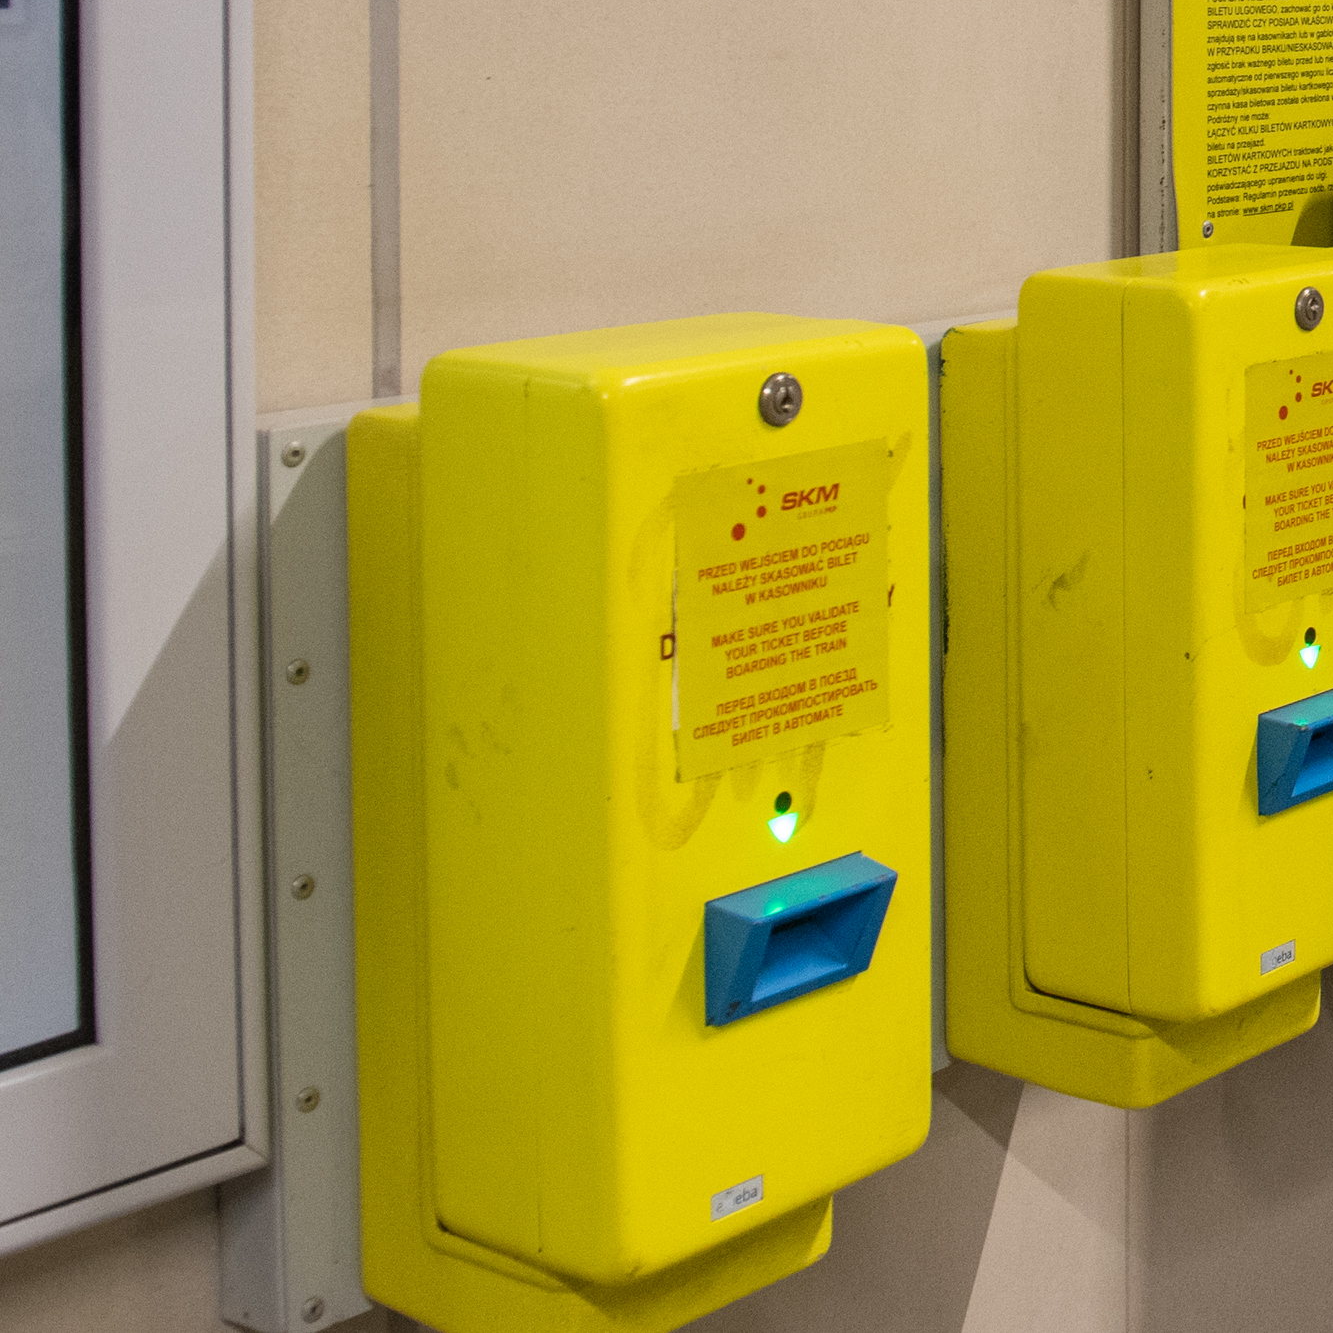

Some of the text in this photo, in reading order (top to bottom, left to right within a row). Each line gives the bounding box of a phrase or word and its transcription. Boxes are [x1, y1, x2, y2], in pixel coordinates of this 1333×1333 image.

[781, 483, 839, 511] SKM
[698, 534, 869, 579] PRZED WEJŚCIEM DO POCIĄGU
[712, 551, 857, 594] NALEŻY SKASOWAĆ BILET
[745, 577, 828, 604] W KASOWNIKU
[711, 600, 858, 647] MAKE SURE YOU VALIDATE
[725, 620, 846, 659] YOUR TICKET BEFORE
[726, 638, 846, 678] BOARDING THE TRAIN
[693, 679, 877, 739] СЛЕДУЕТ ПРОКОМПОСТИРОВАТЬ
[716, 667, 856, 714] ПЕРЕД ВХОДОМ В ПОЕЗД
[732, 704, 842, 746] БИЛЕТ В АВТОМАТЕ
